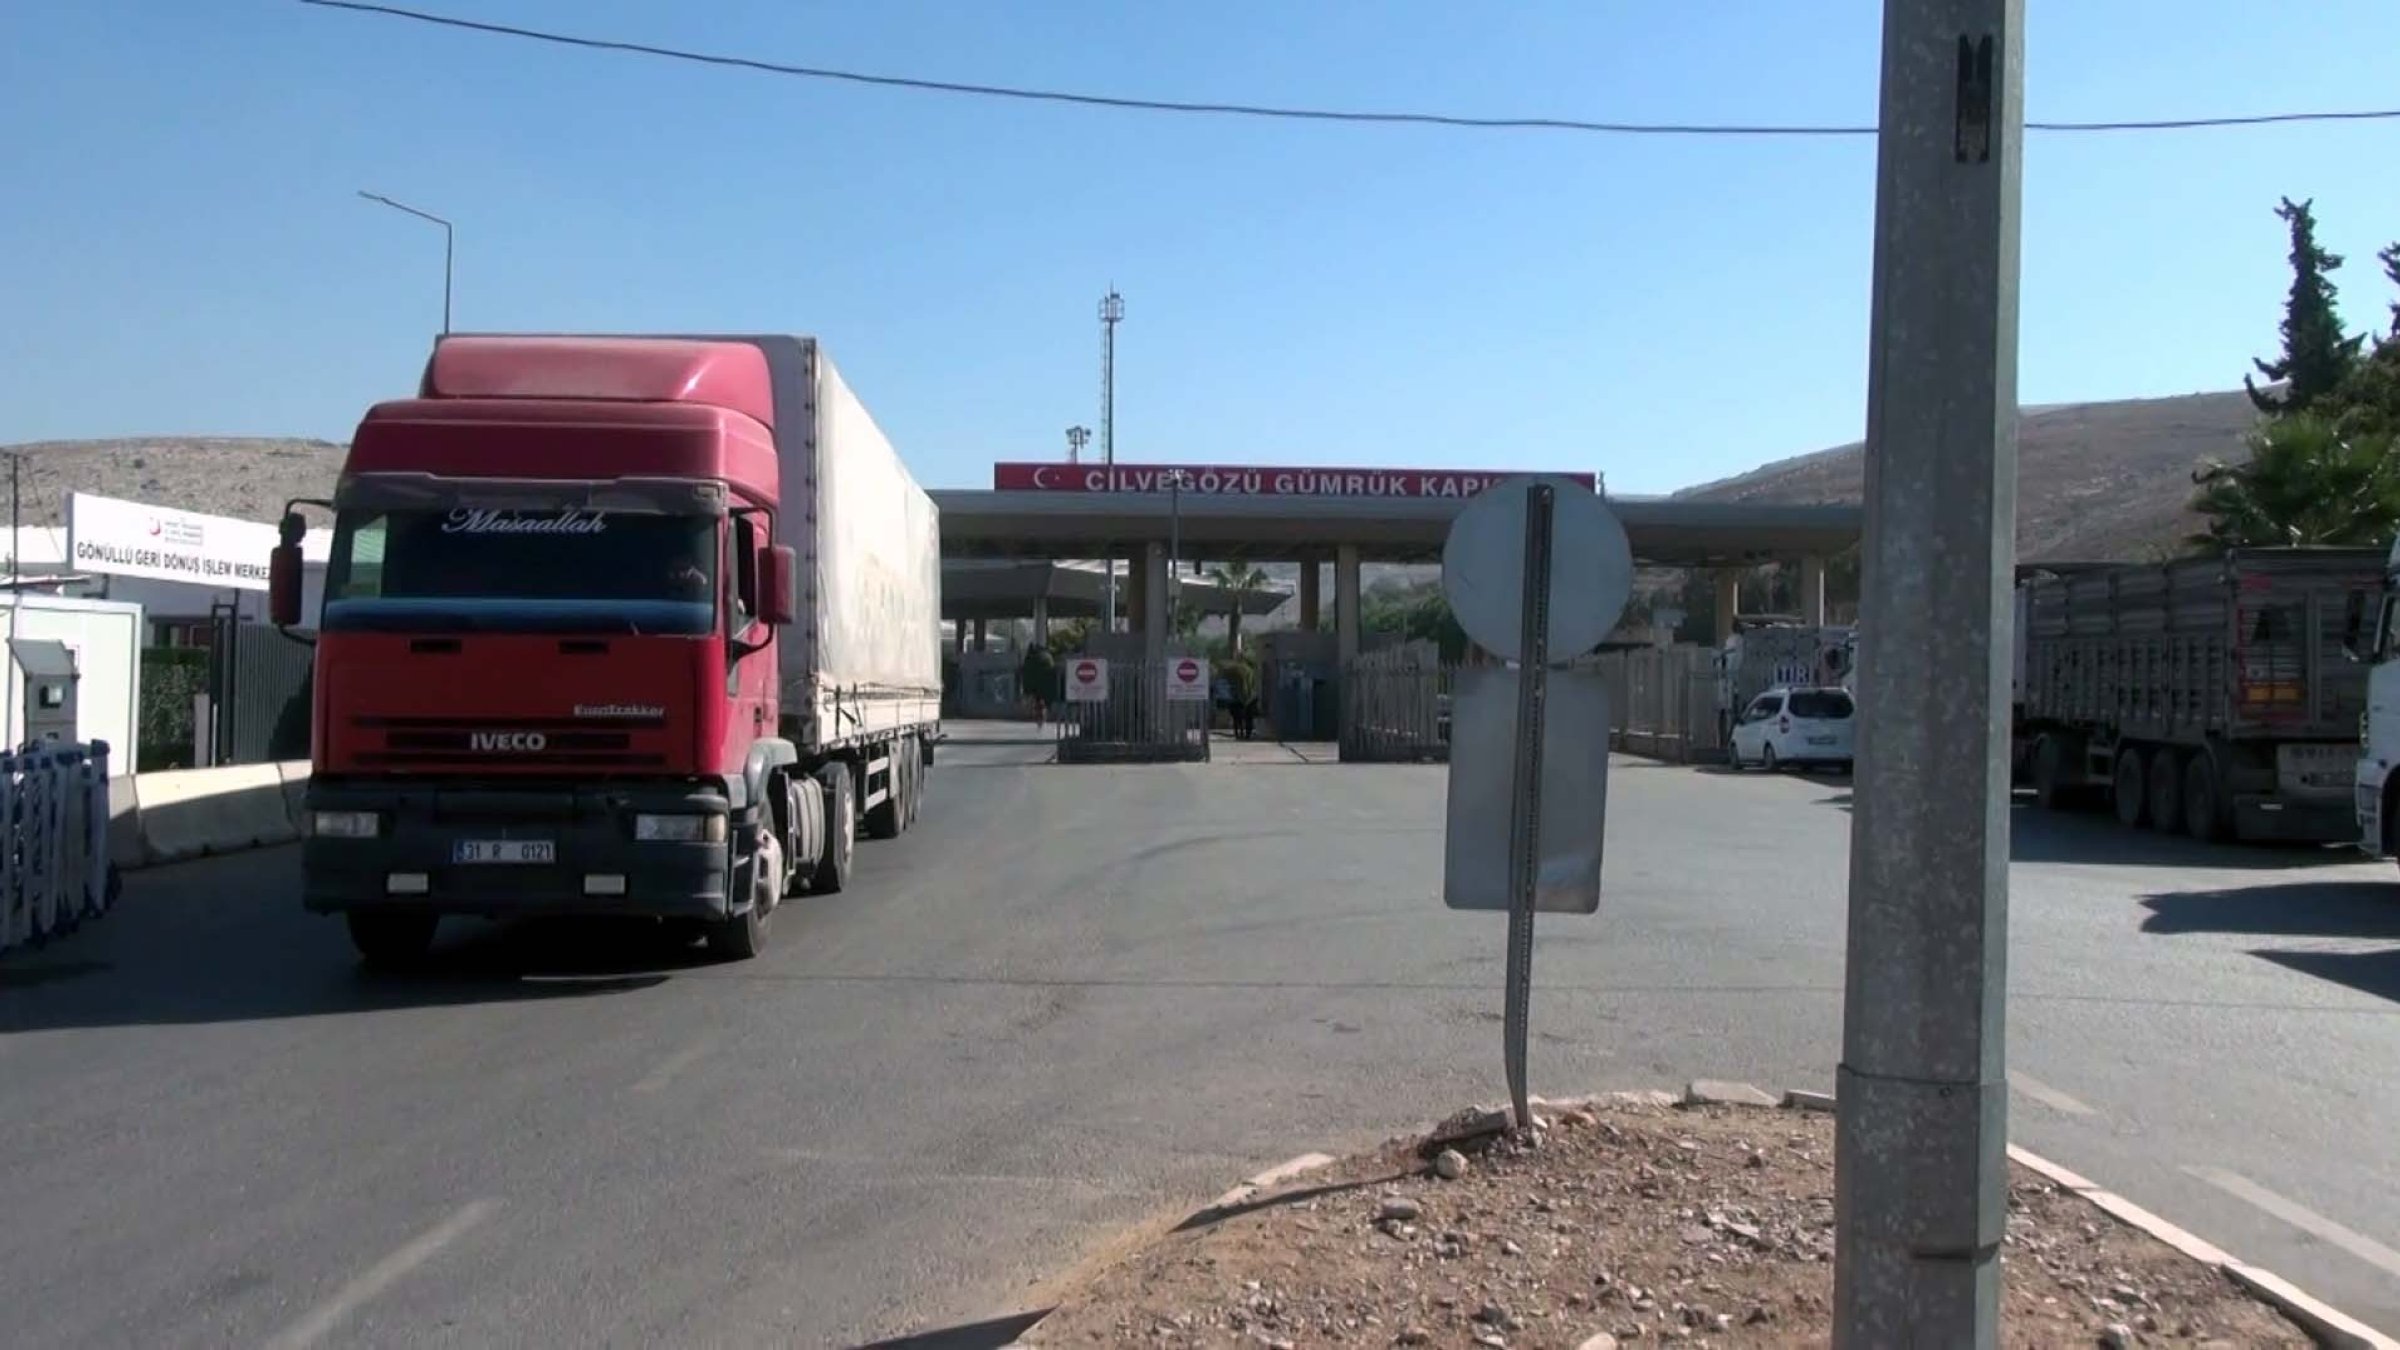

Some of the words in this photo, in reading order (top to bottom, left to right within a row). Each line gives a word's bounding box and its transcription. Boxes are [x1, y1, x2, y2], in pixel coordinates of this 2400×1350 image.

[1275, 468, 1407, 495] GÜMRÜK
[77, 541, 132, 565] GÖNÜLLÜ
[135, 549, 161, 567] GERİ
[164, 552, 200, 574] DÖNÜŞ
[471, 733, 546, 751] IVECO
[466, 844, 480, 860] 31
[492, 844, 502, 859] R
[521, 843, 551, 860] 0121
